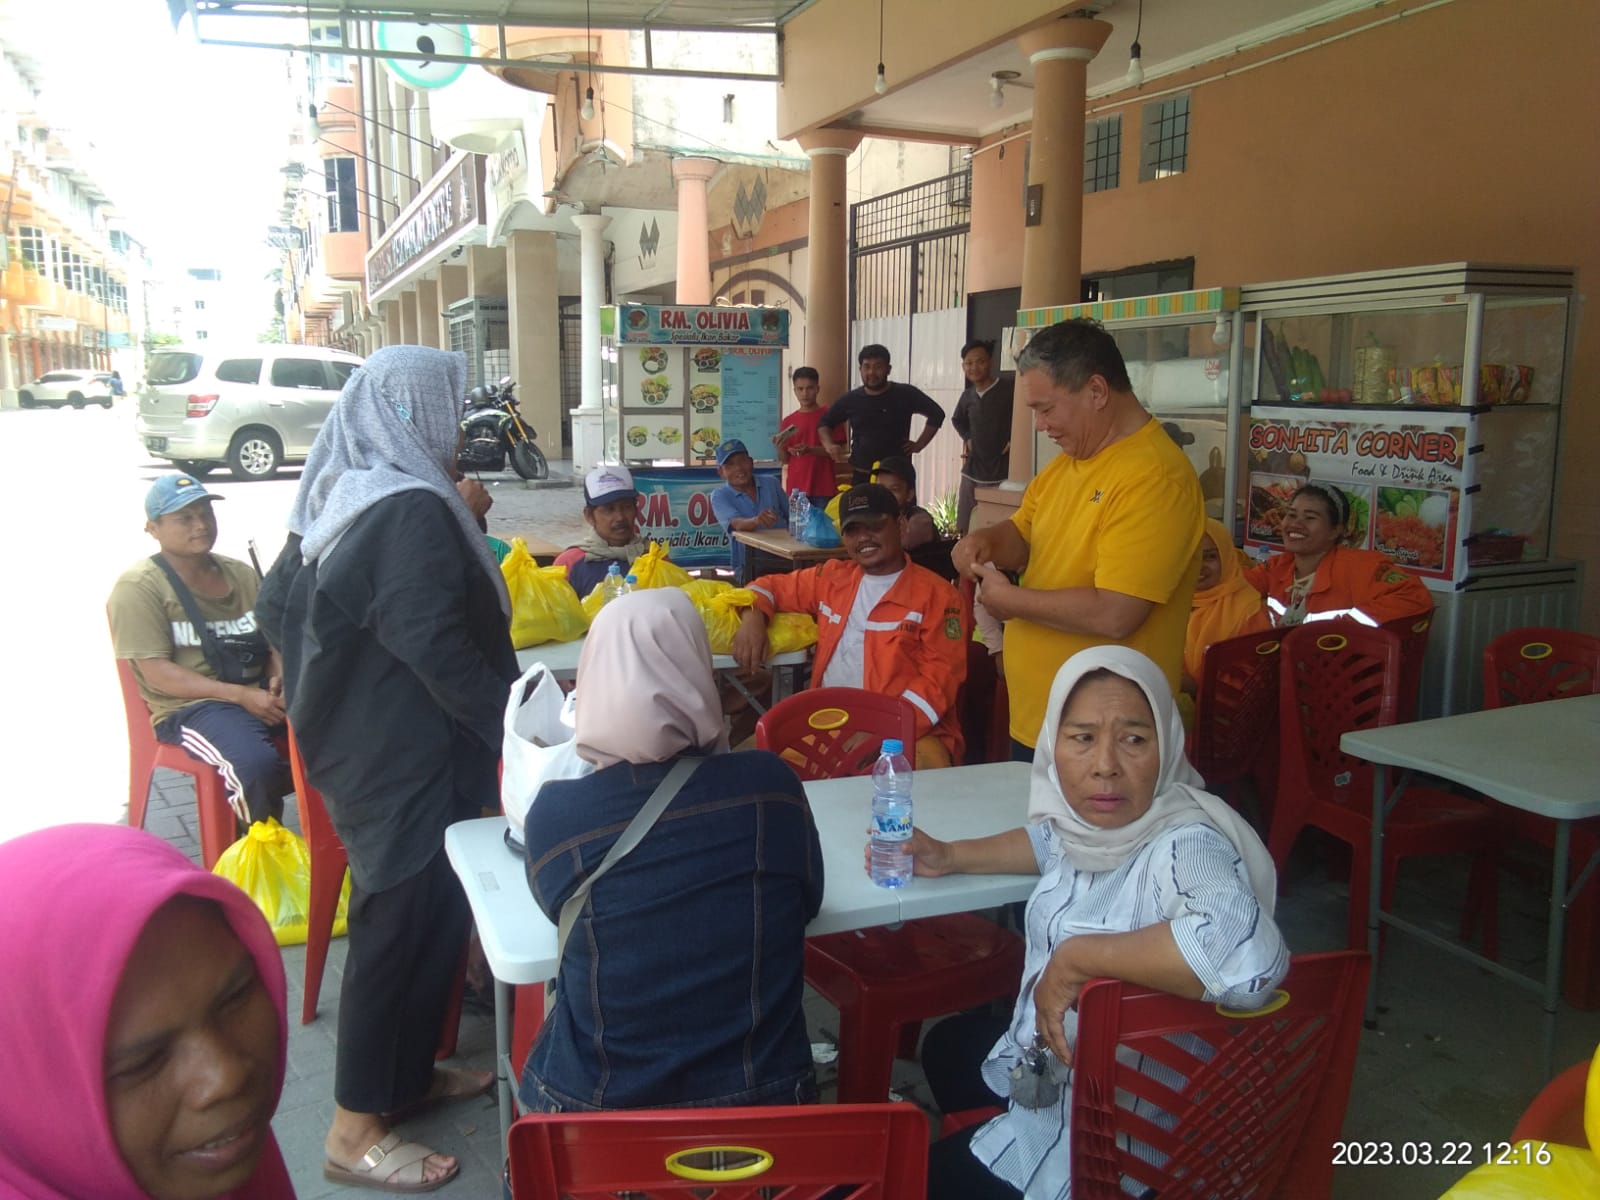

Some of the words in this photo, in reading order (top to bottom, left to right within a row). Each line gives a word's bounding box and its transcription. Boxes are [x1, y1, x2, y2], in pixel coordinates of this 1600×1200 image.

[660, 310, 692, 329] RM.
[697, 311, 750, 330] OLIVIA
[1250, 425, 1349, 454] SONHITA
[1356, 431, 1458, 463] CORNER
[1352, 461, 1377, 476] Food
[1379, 463, 1388, 476] &
[1392, 464, 1425, 480] Drink
[1428, 466, 1454, 483] Area
[694, 531, 719, 546] Ikan
